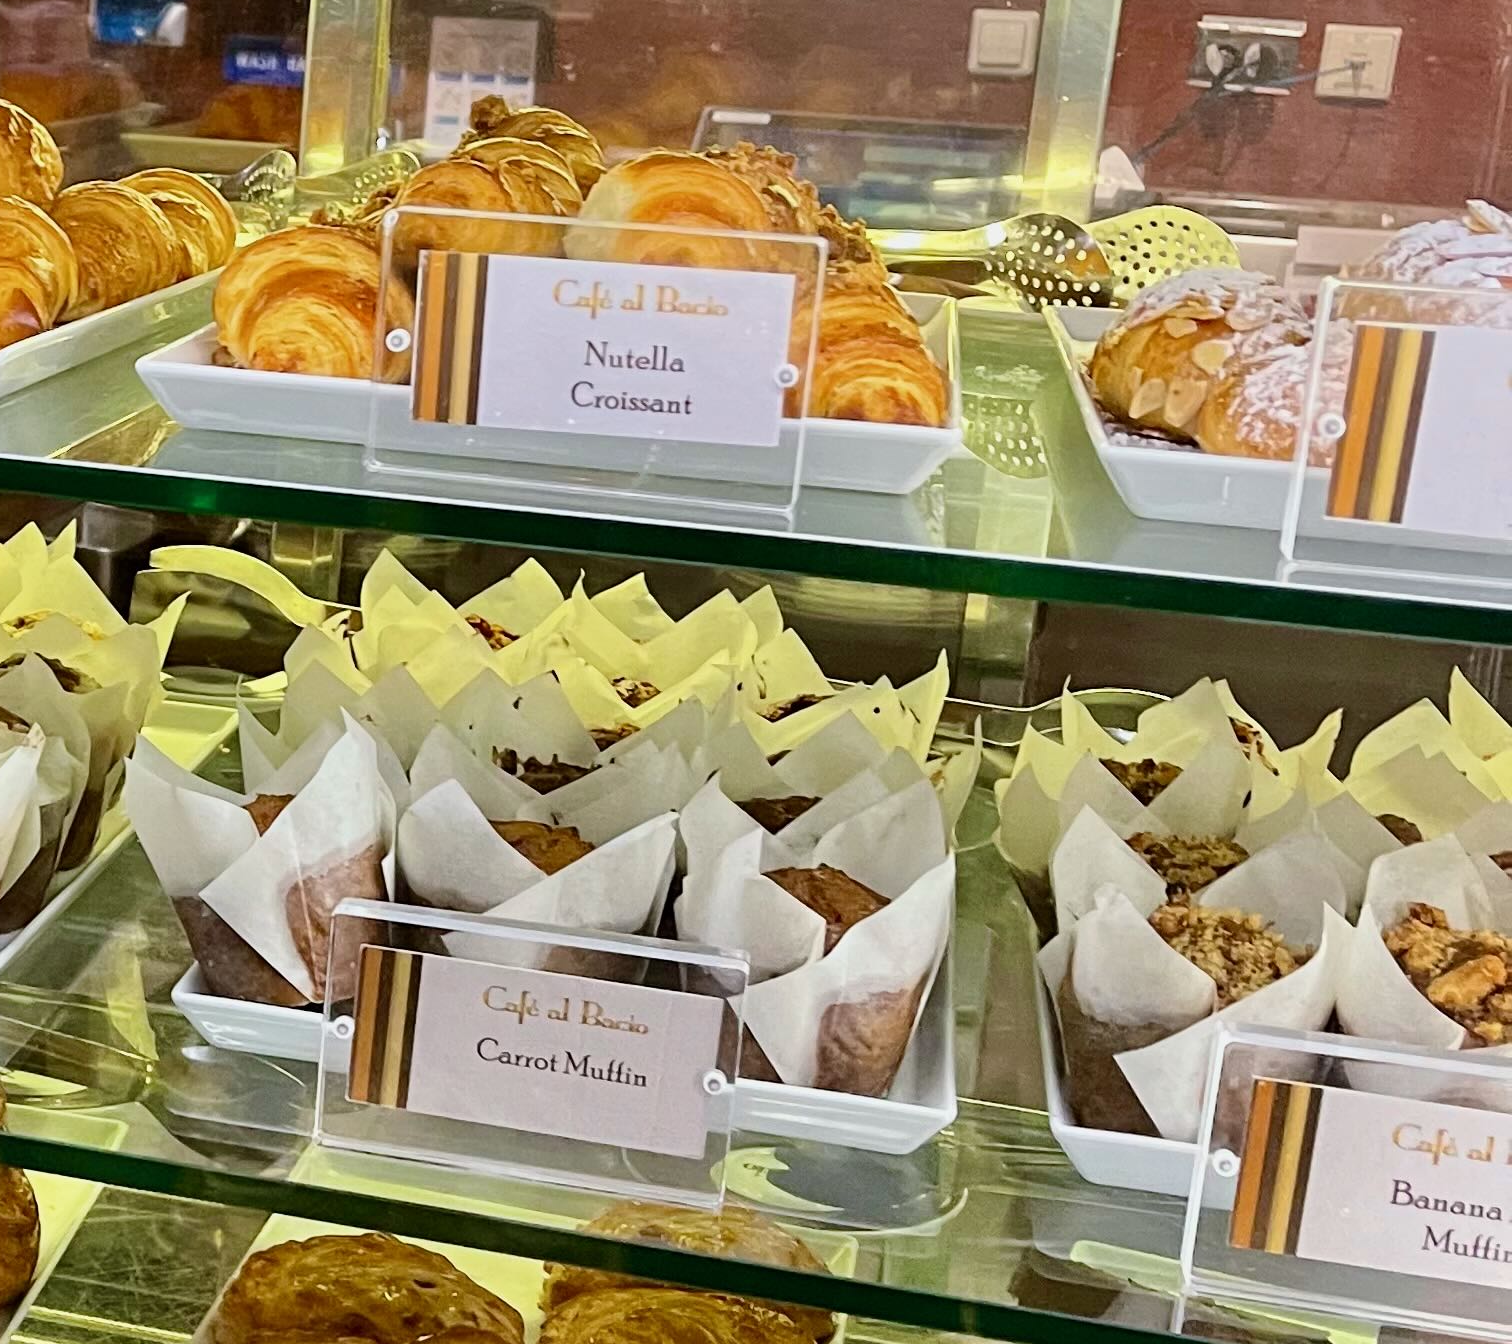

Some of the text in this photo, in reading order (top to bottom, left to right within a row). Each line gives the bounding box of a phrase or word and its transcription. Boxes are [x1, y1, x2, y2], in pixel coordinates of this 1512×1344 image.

[552, 279, 729, 319] Café al Bacio
[584, 340, 686, 373] Nutella
[571, 380, 693, 415] Croissant
[482, 985, 649, 1035] Café al Bacio
[476, 1037, 647, 1088] Carrot Muffin
[1466, 1136, 1495, 1162] al
[1390, 1179, 1503, 1221] Banana
